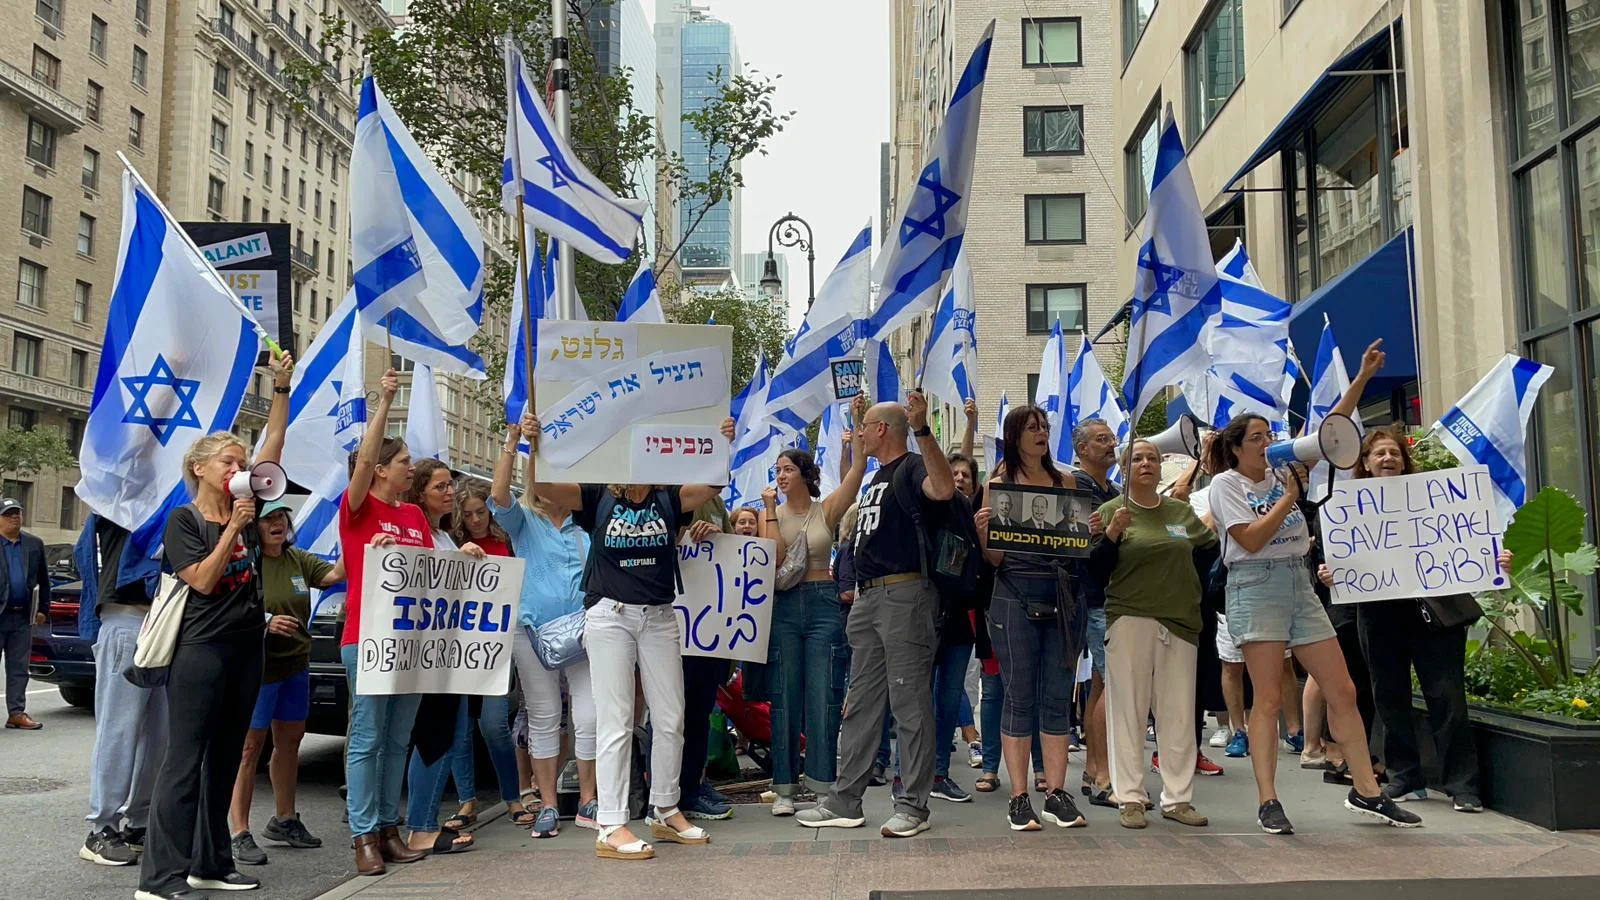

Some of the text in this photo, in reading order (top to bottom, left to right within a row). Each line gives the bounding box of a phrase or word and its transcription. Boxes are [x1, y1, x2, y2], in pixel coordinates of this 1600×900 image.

[204, 238, 267, 262] ALANT.
[222, 274, 261, 290] UST
[241, 295, 263, 311] TE
[551, 328, 624, 360] גלנט,
[543, 361, 703, 440] תציל את ישראל
[838, 388, 859, 397] DEM
[646, 436, 713, 455] מביבי!
[1323, 471, 1489, 524] GALLANT
[606, 518, 668, 537] ISRAELI
[612, 503, 659, 525] SAVING
[605, 533, 668, 548] DEMOCRACY
[990, 530, 1088, 549] שתיקת הכבשים
[1329, 520, 1402, 559] SAVE
[1408, 510, 1500, 548] ISRAEL
[738, 541, 769, 568] בלי
[381, 552, 501, 592] SAVING
[1331, 567, 1399, 598] FROM
[715, 563, 767, 613] אין
[393, 596, 511, 632] ISRAELI
[362, 638, 503, 672] DEMOCRACY
